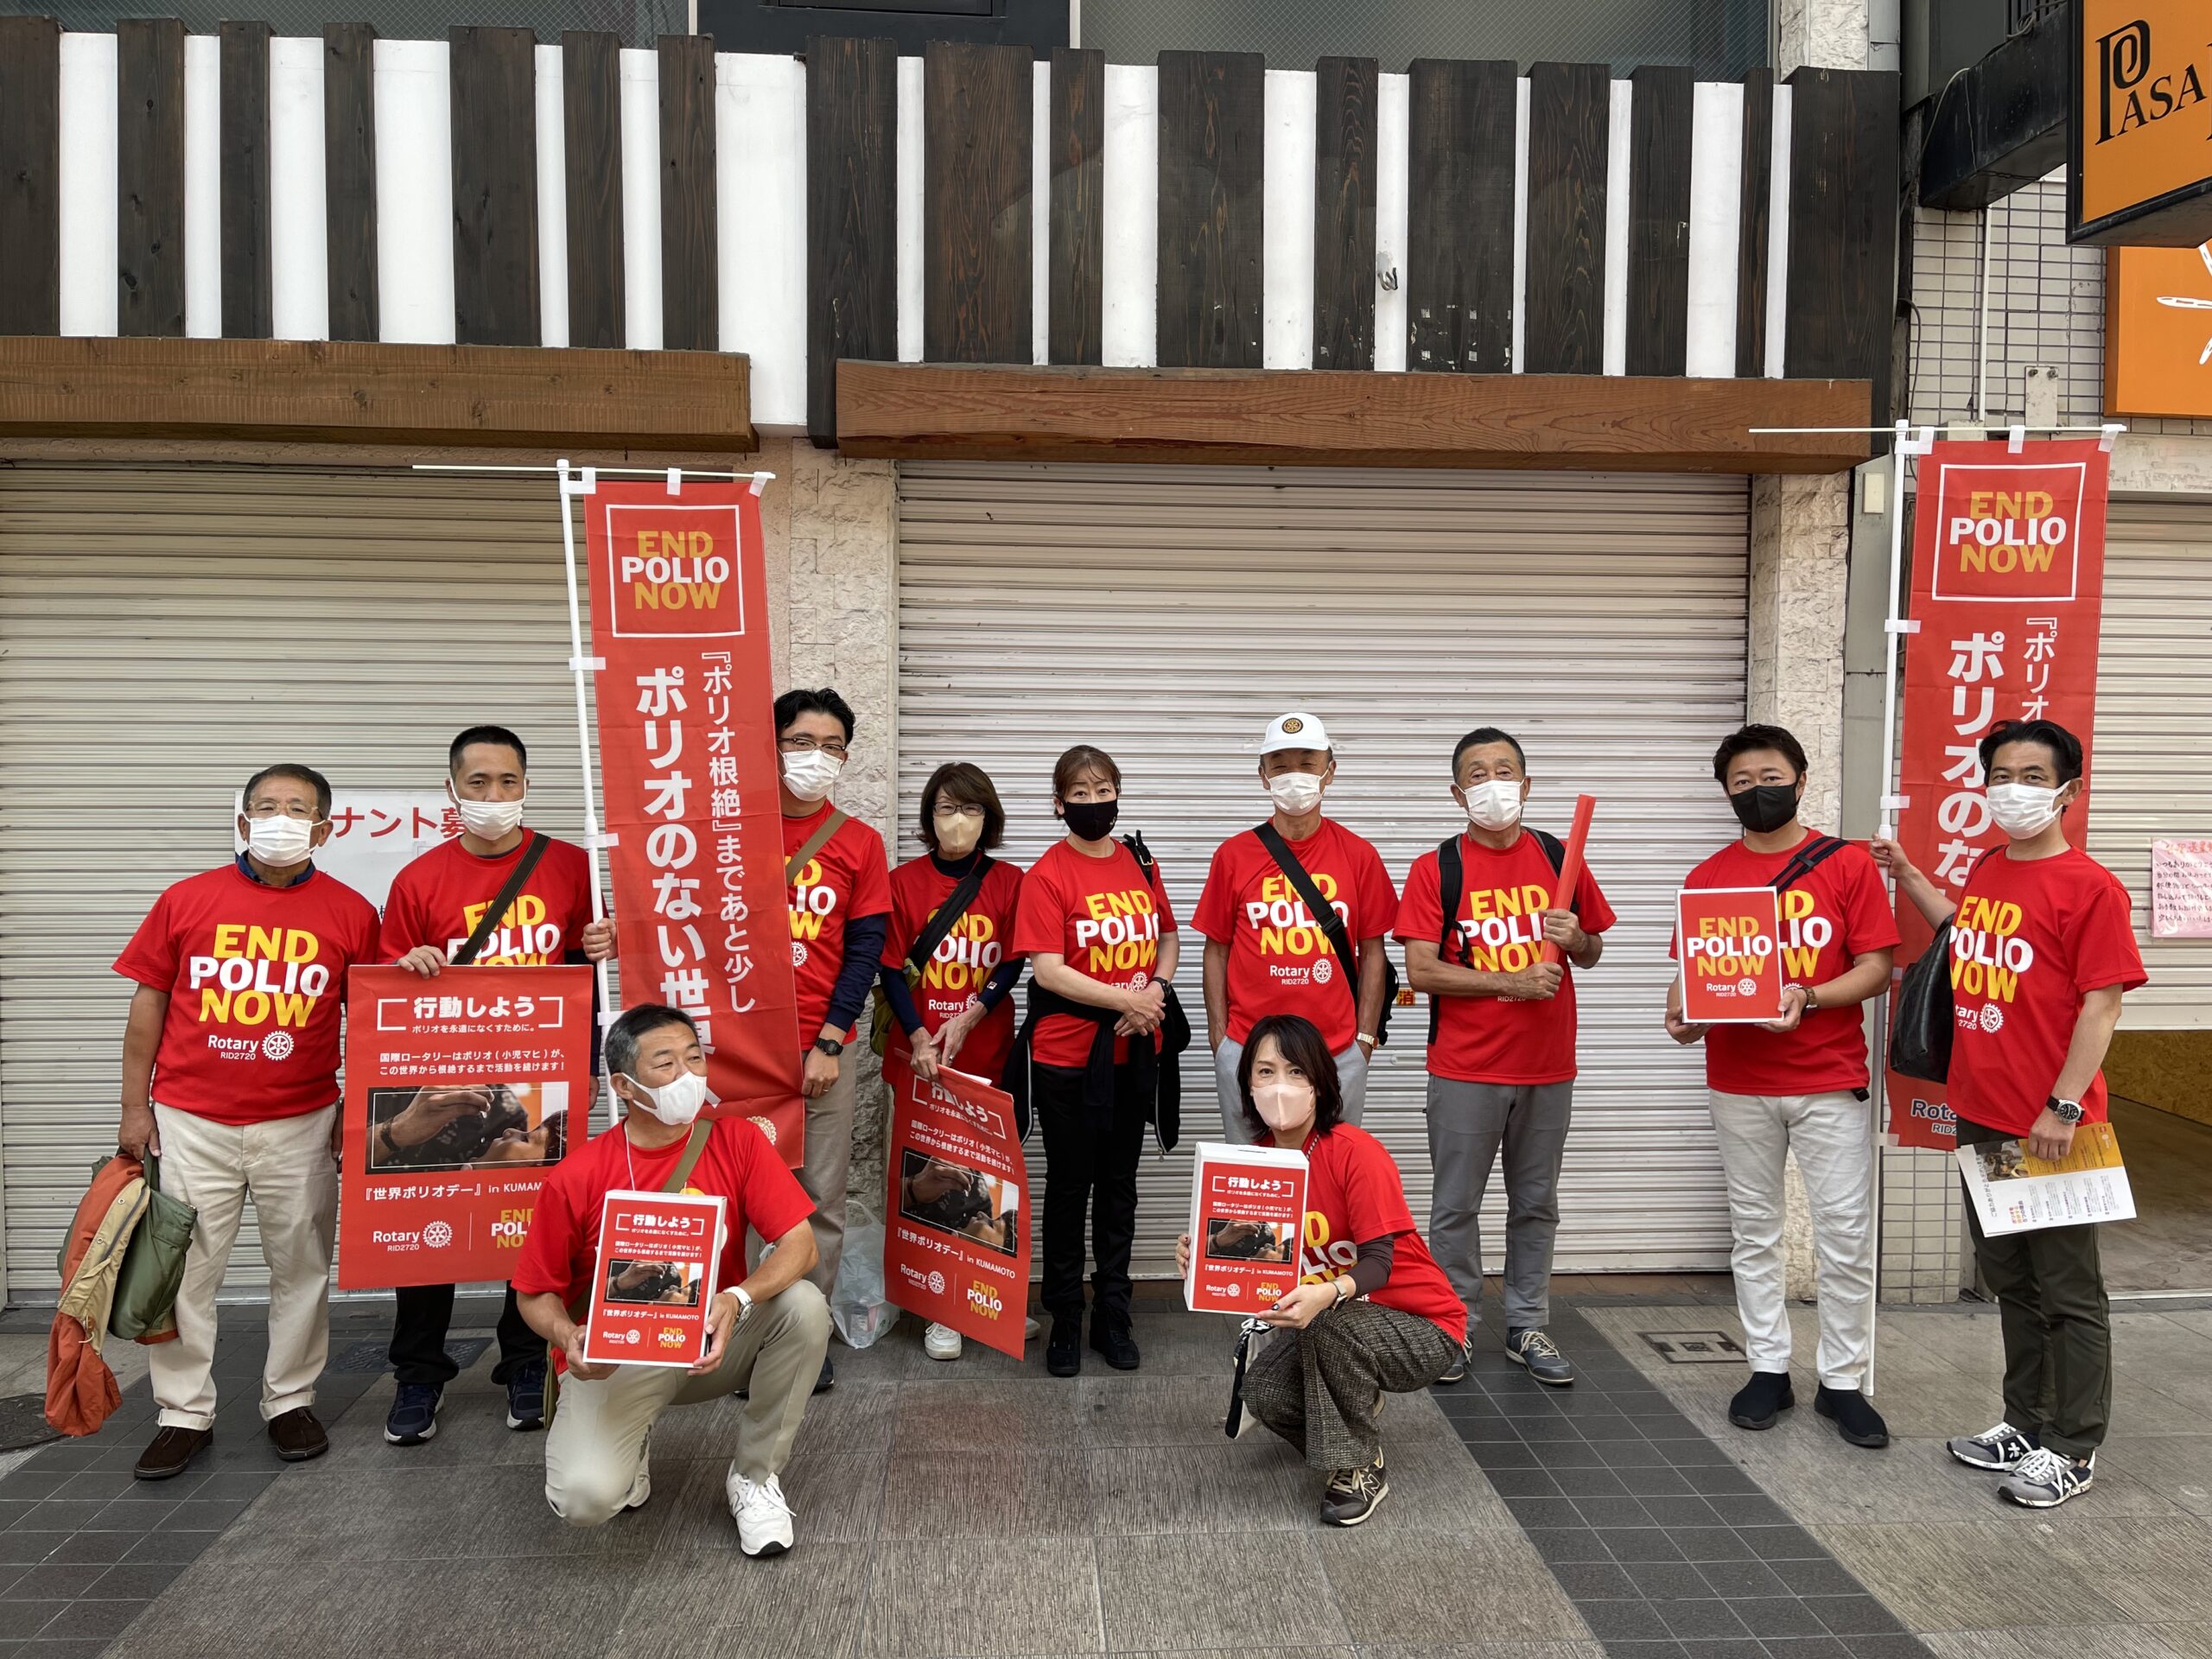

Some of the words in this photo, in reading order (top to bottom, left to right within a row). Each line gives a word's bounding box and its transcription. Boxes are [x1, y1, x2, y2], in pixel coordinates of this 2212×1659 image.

[1969, 491, 2054, 520] END
[1949, 517, 2067, 546] POLIO
[637, 531, 714, 558] END
[621, 556, 729, 584] POLIO
[1960, 543, 2056, 573] NOW
[634, 582, 721, 610] NOW
[2021, 617, 2058, 722] 『ポリオ
[1934, 632, 2005, 890] ポリオのな
[331, 807, 467, 839] ナント募
[701, 651, 756, 1014] 『ポリオ根絶』まであと少し
[636, 665, 721, 1109] ポリオのない世
[1085, 889, 1153, 921] END
[1470, 884, 1550, 920] END
[927, 909, 994, 943] ND
[1246, 899, 1350, 930] POLO
[1955, 895, 2022, 937] END
[1457, 912, 1549, 947] POLI
[1699, 916, 1759, 938] END
[213, 923, 320, 964] END
[918, 931, 1002, 969] OLIO
[1687, 935, 1772, 957] POLIO
[1090, 939, 1157, 973] NOW
[1697, 955, 1766, 977] NOW
[189, 956, 330, 997] POLIO
[922, 961, 994, 994] NOW
[1269, 964, 1310, 978] Rotary
[1706, 982, 1736, 993] Rotary
[198, 988, 317, 1028] NOW
[413, 996, 535, 1020] 行動しよう
[928, 999, 964, 1011] Rotary
[1955, 1004, 1978, 1023] tary
[411, 1023, 535, 1034] ポリオを永遠になくすために。
[1957, 1019, 1978, 1031] 2720
[207, 1034, 259, 1052] Rotary
[220, 1052, 257, 1061] RID2720
[1910, 1098, 1957, 1122] Rota
[1931, 1122, 1957, 1135] RID2
[365, 1183, 481, 1201] 『世界ポリオデー』
[488, 1185, 499, 1193] in
[504, 1181, 543, 1192] KUMAM
[372, 1230, 420, 1244] Rotary
[491, 1221, 528, 1237] POL
[387, 1243, 420, 1252] RID2720
[497, 1234, 526, 1249] NO
[898, 1227, 963, 1262] 『世界ポリオデー』
[967, 1255, 975, 1264] in
[976, 1258, 1015, 1279] KUMAMOTO
[900, 1263, 927, 1283] Rotary
[967, 1288, 1002, 1312] POLIO
[972, 1280, 998, 1299] END
[1205, 1284, 1227, 1294] Rotary
[1256, 1287, 1282, 1296] POLIO
[970, 1300, 999, 1320] NOW
[602, 1331, 626, 1340] Rotary
[658, 1333, 686, 1342] POLIO
